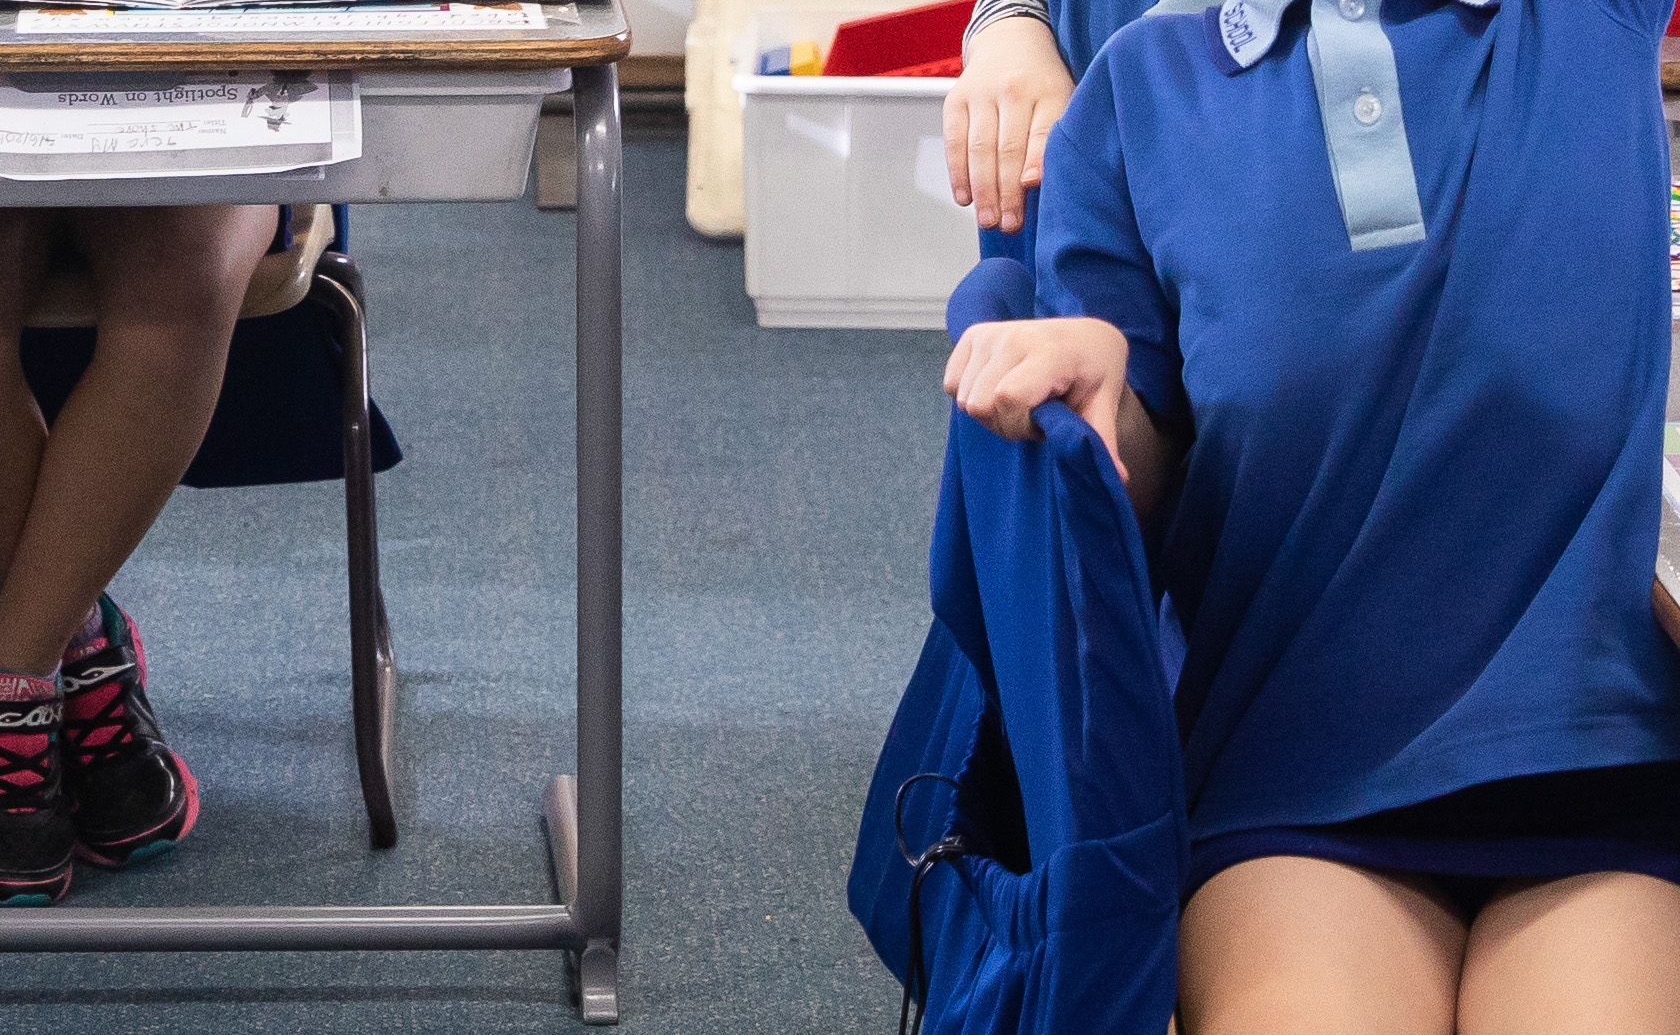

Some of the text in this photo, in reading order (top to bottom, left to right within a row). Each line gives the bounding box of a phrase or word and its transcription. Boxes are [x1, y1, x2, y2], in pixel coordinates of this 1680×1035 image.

[56, 85, 238, 106] Spotlight on Words
